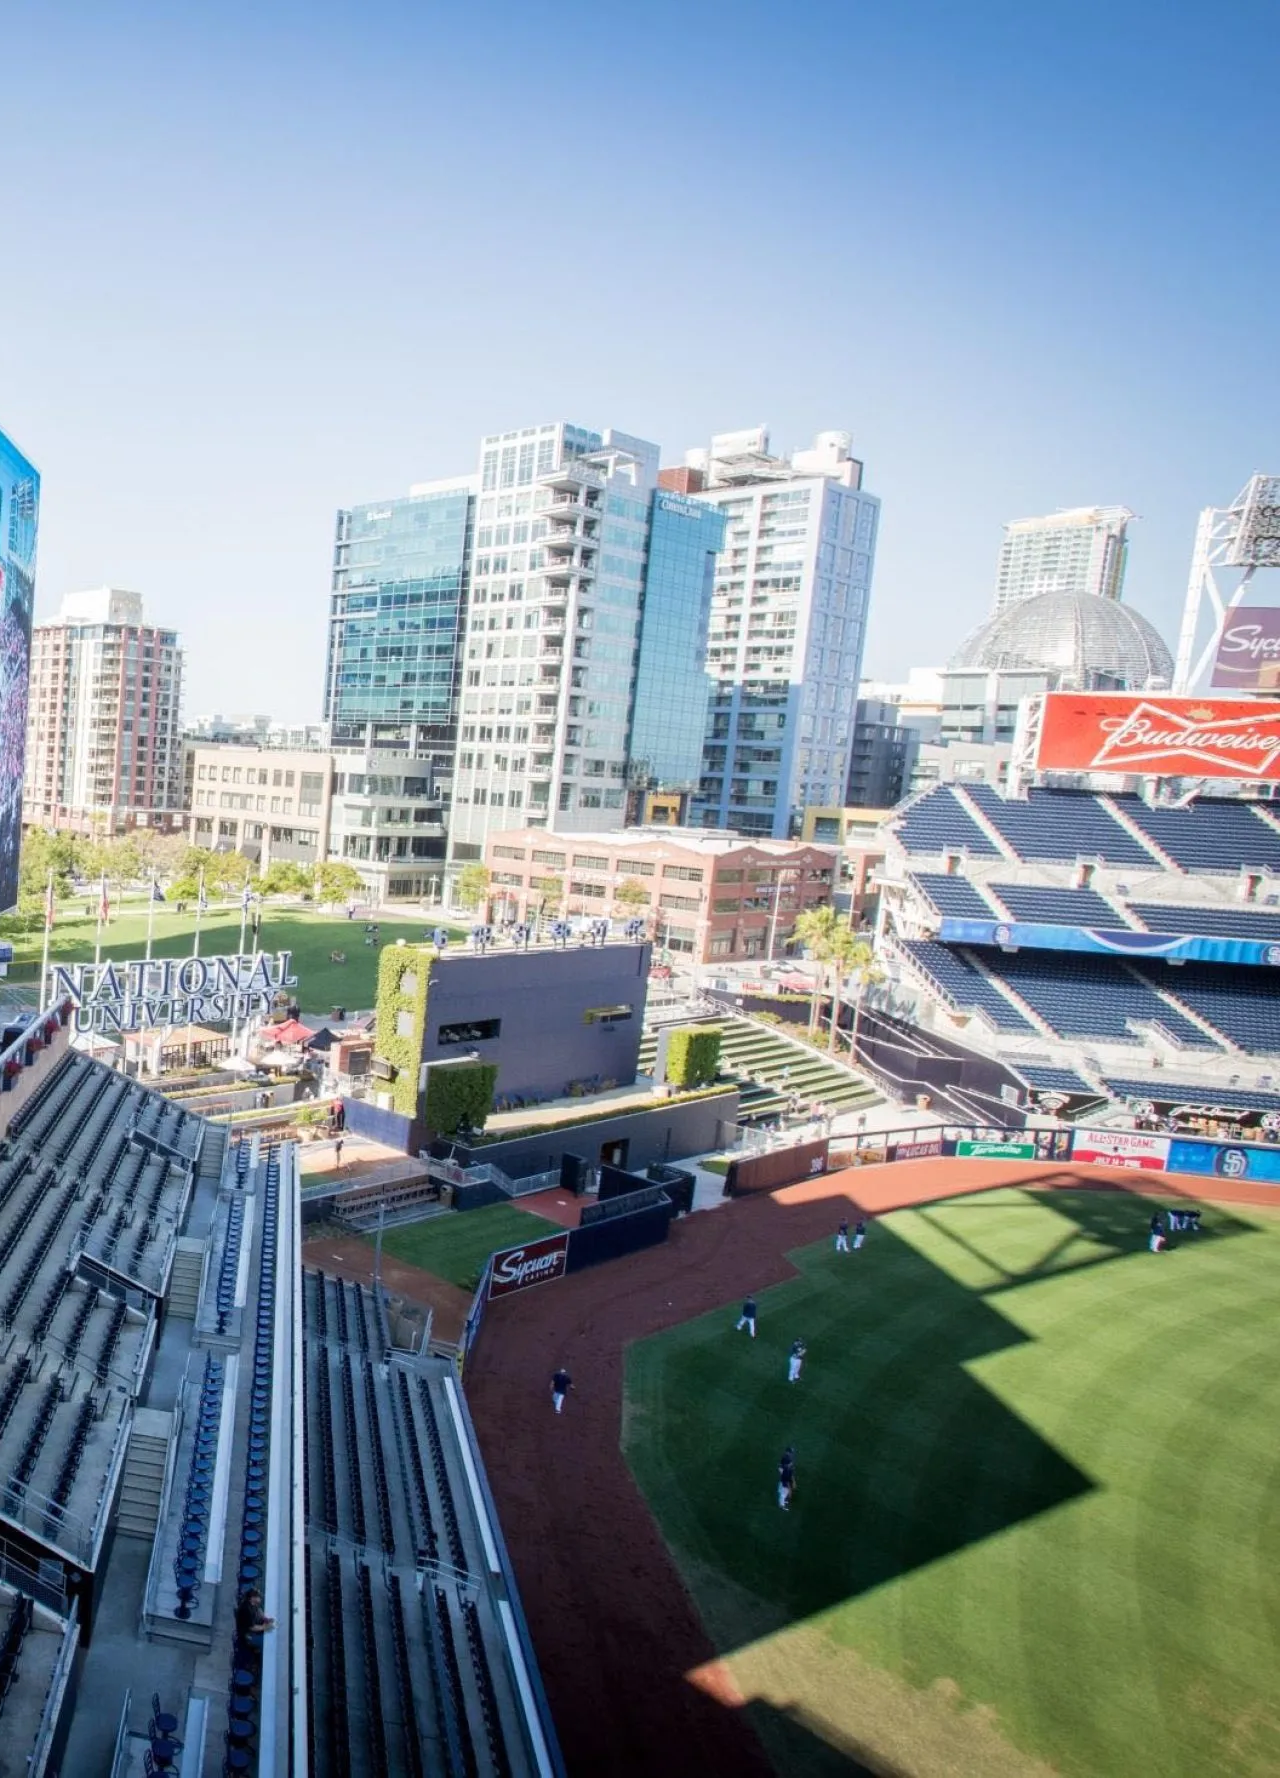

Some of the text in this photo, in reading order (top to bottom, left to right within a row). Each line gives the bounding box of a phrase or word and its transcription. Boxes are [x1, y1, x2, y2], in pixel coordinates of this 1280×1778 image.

[49, 950, 298, 1005] NATIONAL
[72, 988, 279, 1033] UNIVERSITY
[500, 1250, 561, 1285] Sycuan
